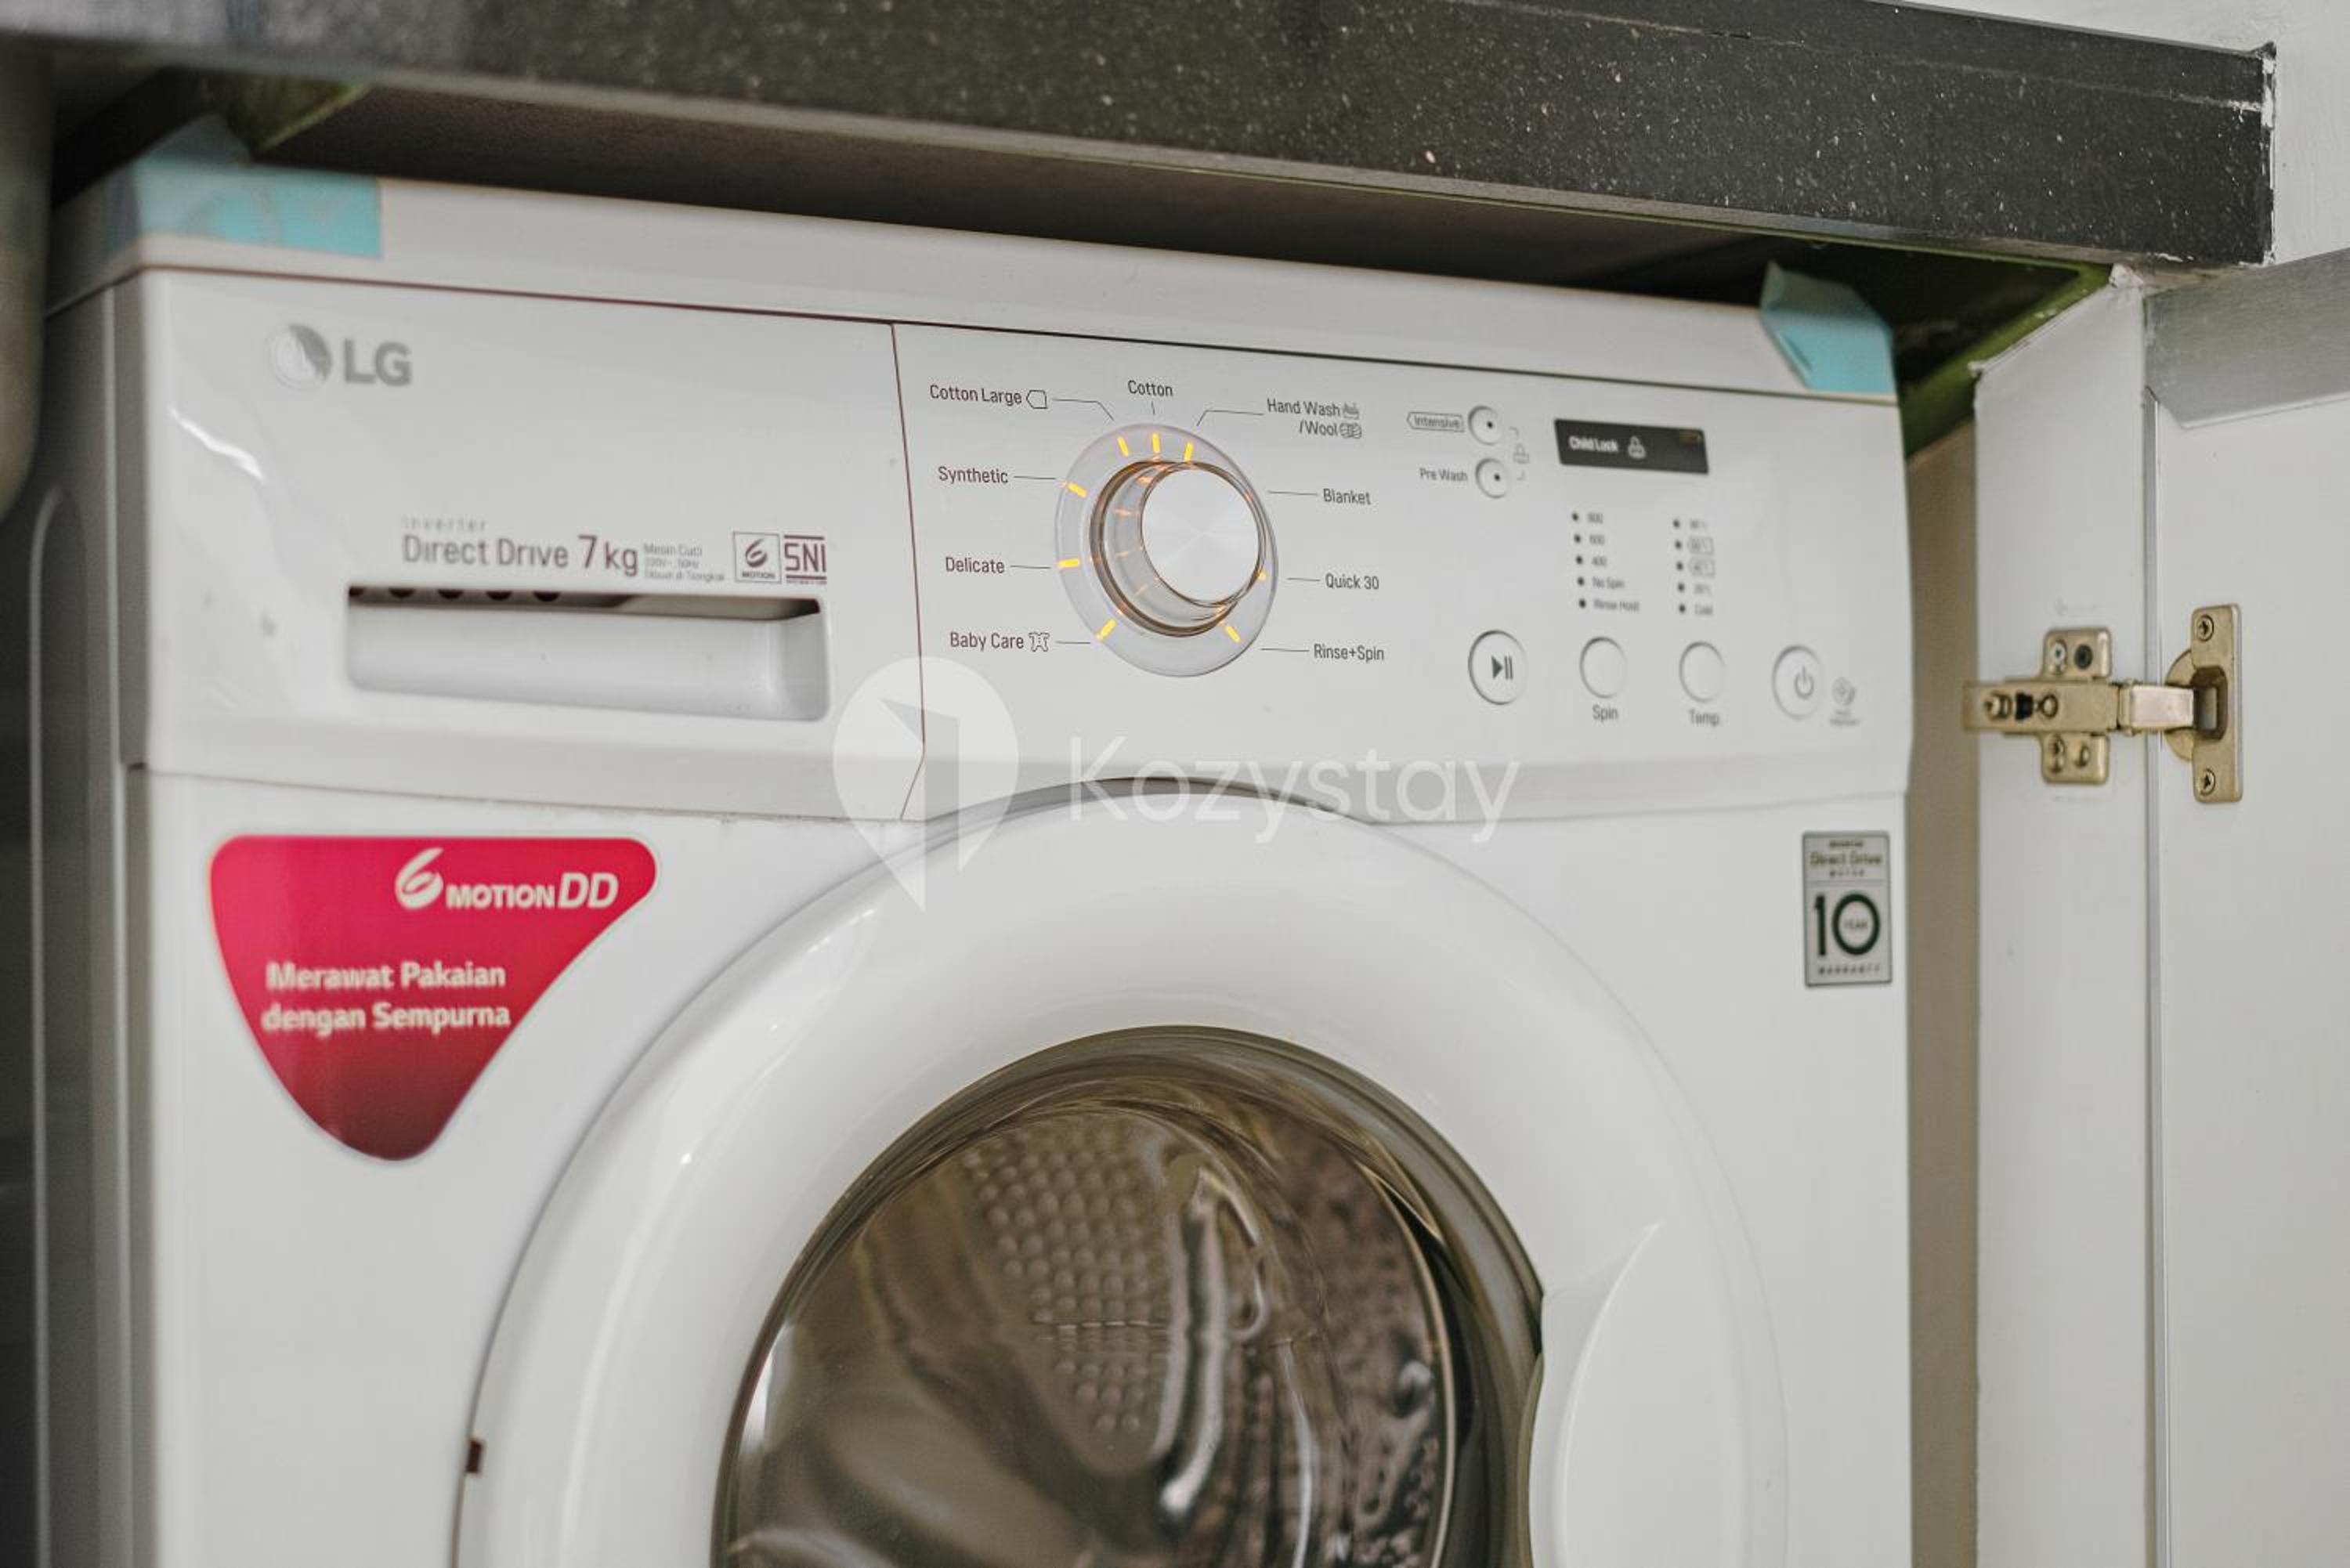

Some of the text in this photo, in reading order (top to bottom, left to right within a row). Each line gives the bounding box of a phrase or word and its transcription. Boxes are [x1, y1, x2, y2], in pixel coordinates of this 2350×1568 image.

[344, 339, 411, 386] LG
[930, 385, 1021, 406] Cotton Large
[1127, 380, 1173, 397] Cotton
[1267, 398, 1340, 417] Hand Wash
[1299, 420, 1338, 437] /Wool
[1414, 415, 1460, 429] Intensive
[1569, 435, 1619, 453] Child Lock
[938, 466, 1009, 486] Synthetic
[1420, 469, 1468, 482] Pre Wash
[1323, 488, 1371, 505] Blanket
[402, 533, 488, 565] Direct
[497, 537, 569, 569] Drive
[784, 542, 827, 573] SNI
[945, 557, 1005, 575] Delicate
[1325, 573, 1379, 591] Quick 30
[949, 632, 1025, 652] Baby Care
[1314, 644, 1385, 663] Rinse+Spin
[1593, 704, 1619, 723] Spin
[1813, 893, 1880, 956] 10
[266, 960, 506, 990] Merawat Pakaian
[262, 1002, 512, 1038] dengan Sempurna
